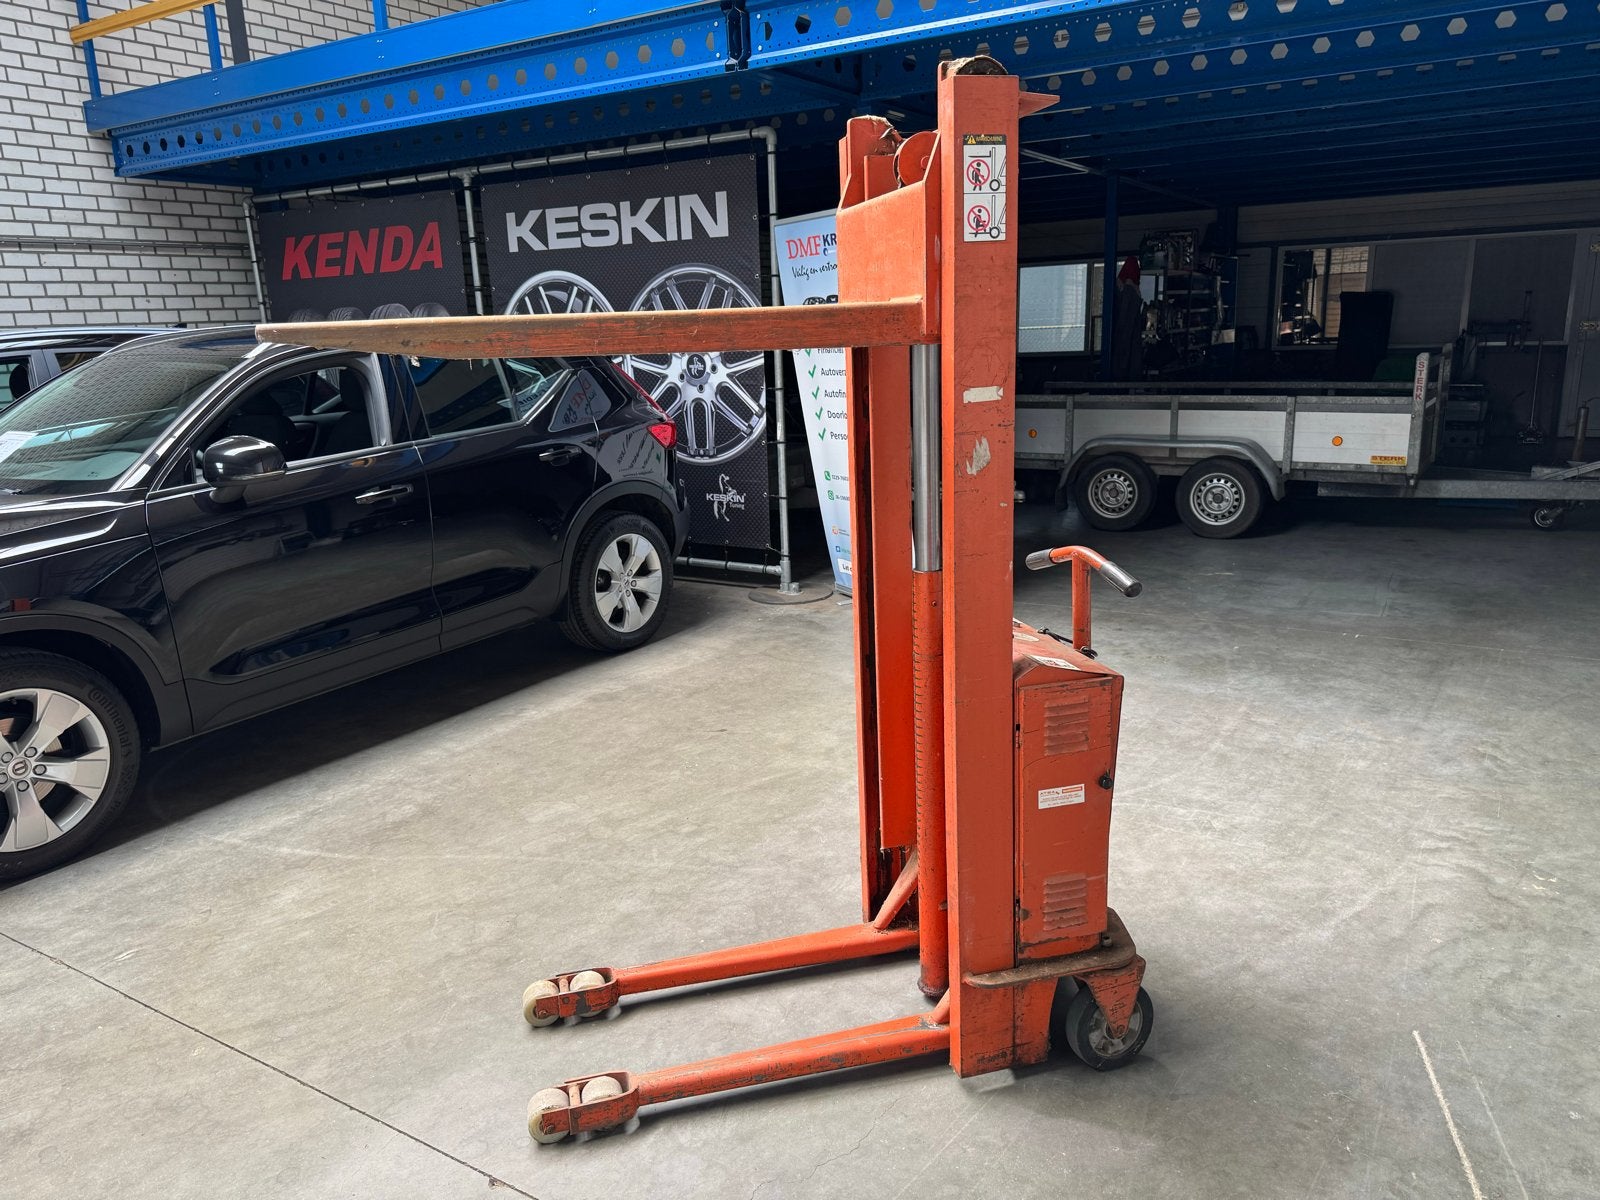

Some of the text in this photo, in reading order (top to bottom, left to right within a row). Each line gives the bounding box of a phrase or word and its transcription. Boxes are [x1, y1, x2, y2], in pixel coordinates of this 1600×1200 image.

[506, 190, 729, 253] KESKIN
[282, 221, 443, 281] KENDA
[786, 235, 820, 260] DMF
[1415, 361, 1425, 401] STERK
[706, 492, 744, 503] KESKIN
